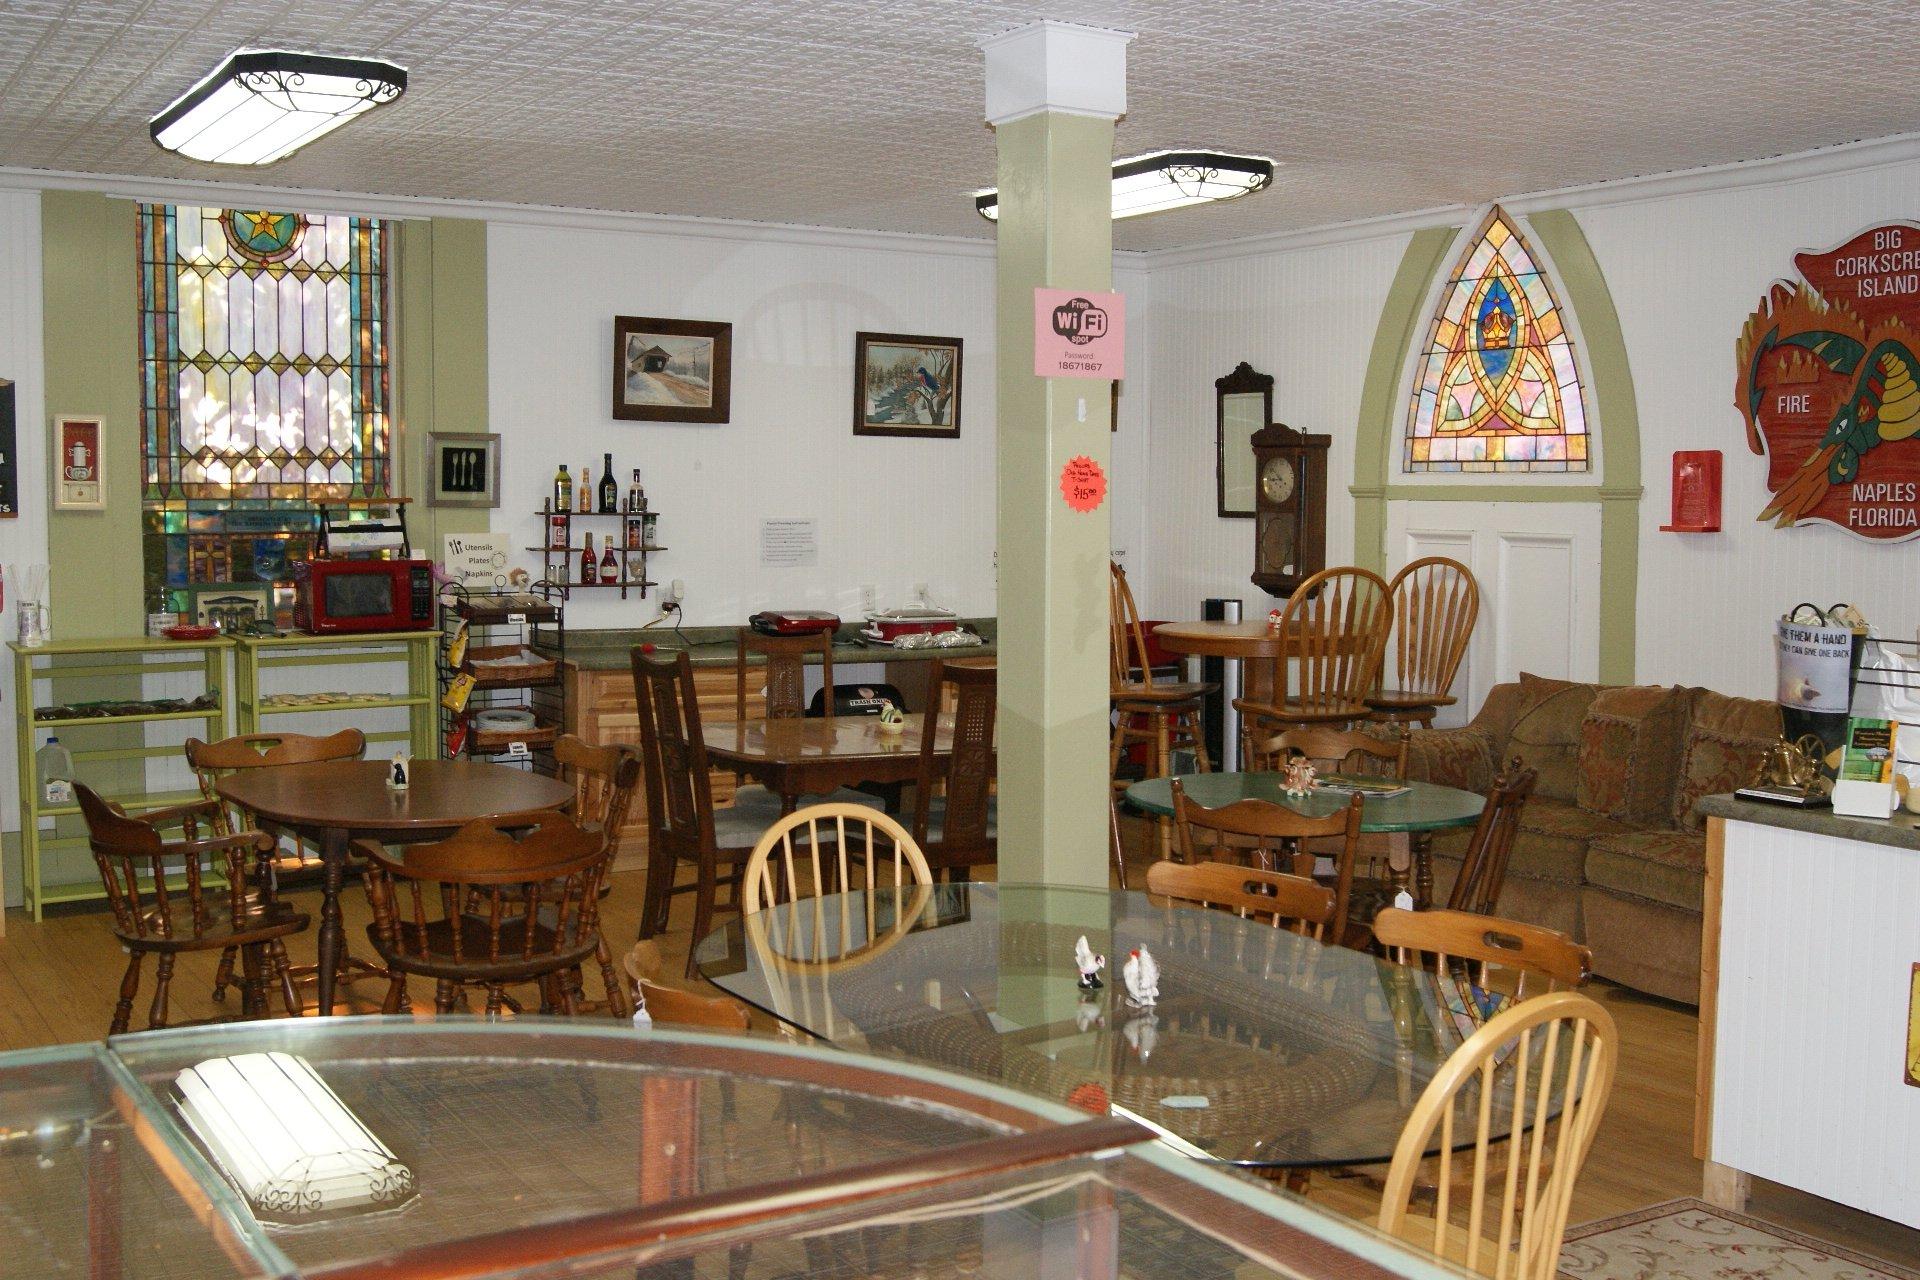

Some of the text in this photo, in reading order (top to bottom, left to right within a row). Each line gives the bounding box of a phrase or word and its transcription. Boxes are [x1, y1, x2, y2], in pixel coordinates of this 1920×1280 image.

[1874, 229, 1902, 251] BIG
[1857, 274, 1918, 298] ISLAND
[1071, 300, 1090, 309] Free
[1064, 351, 1094, 360] Password
[1058, 361, 1103, 372] 18671867
[1778, 395, 1810, 413] FIRE
[1852, 482, 1916, 502] NAPLES
[1849, 507, 1918, 527] FLORIDA
[465, 570, 493, 578] Napkins
[1790, 629, 1812, 643] THEM
[1814, 632, 1820, 644] A
[1822, 633, 1847, 645] HAND
